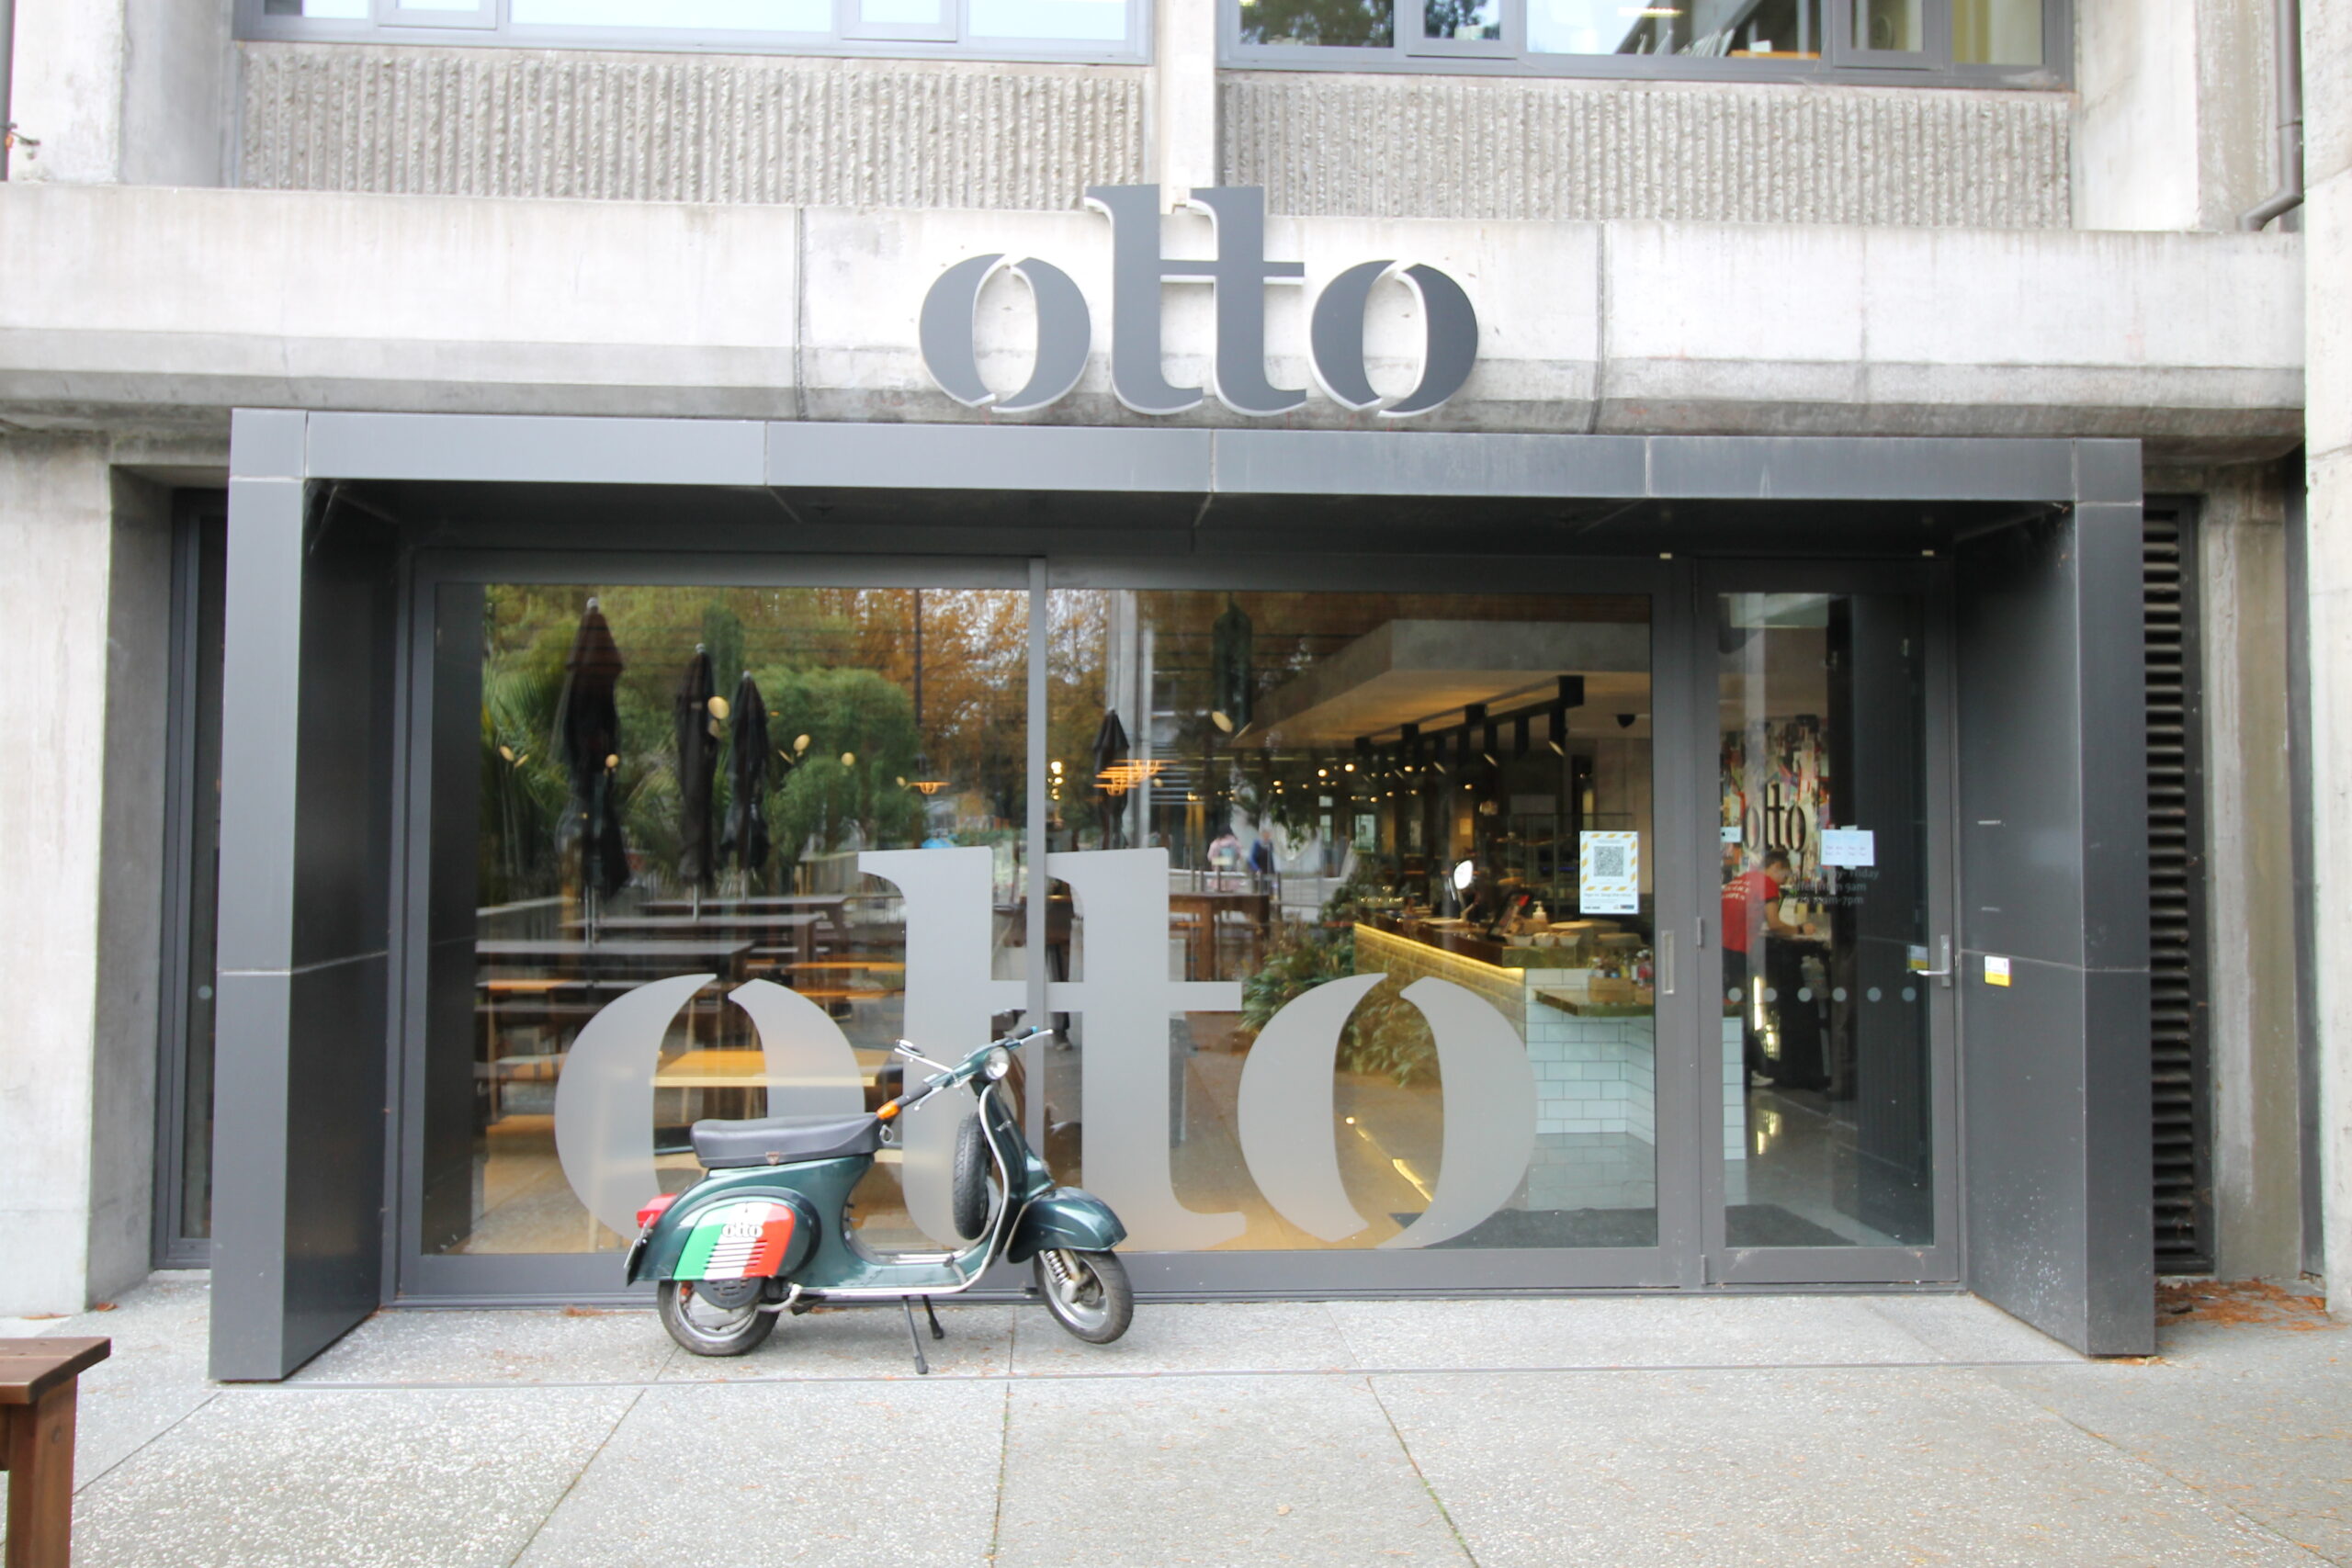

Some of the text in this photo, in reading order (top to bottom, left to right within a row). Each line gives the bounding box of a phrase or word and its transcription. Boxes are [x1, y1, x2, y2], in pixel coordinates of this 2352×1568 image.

[919, 184, 1477, 417] otto
[1742, 781, 1806, 853] otto
[555, 846, 1538, 1251] otto
